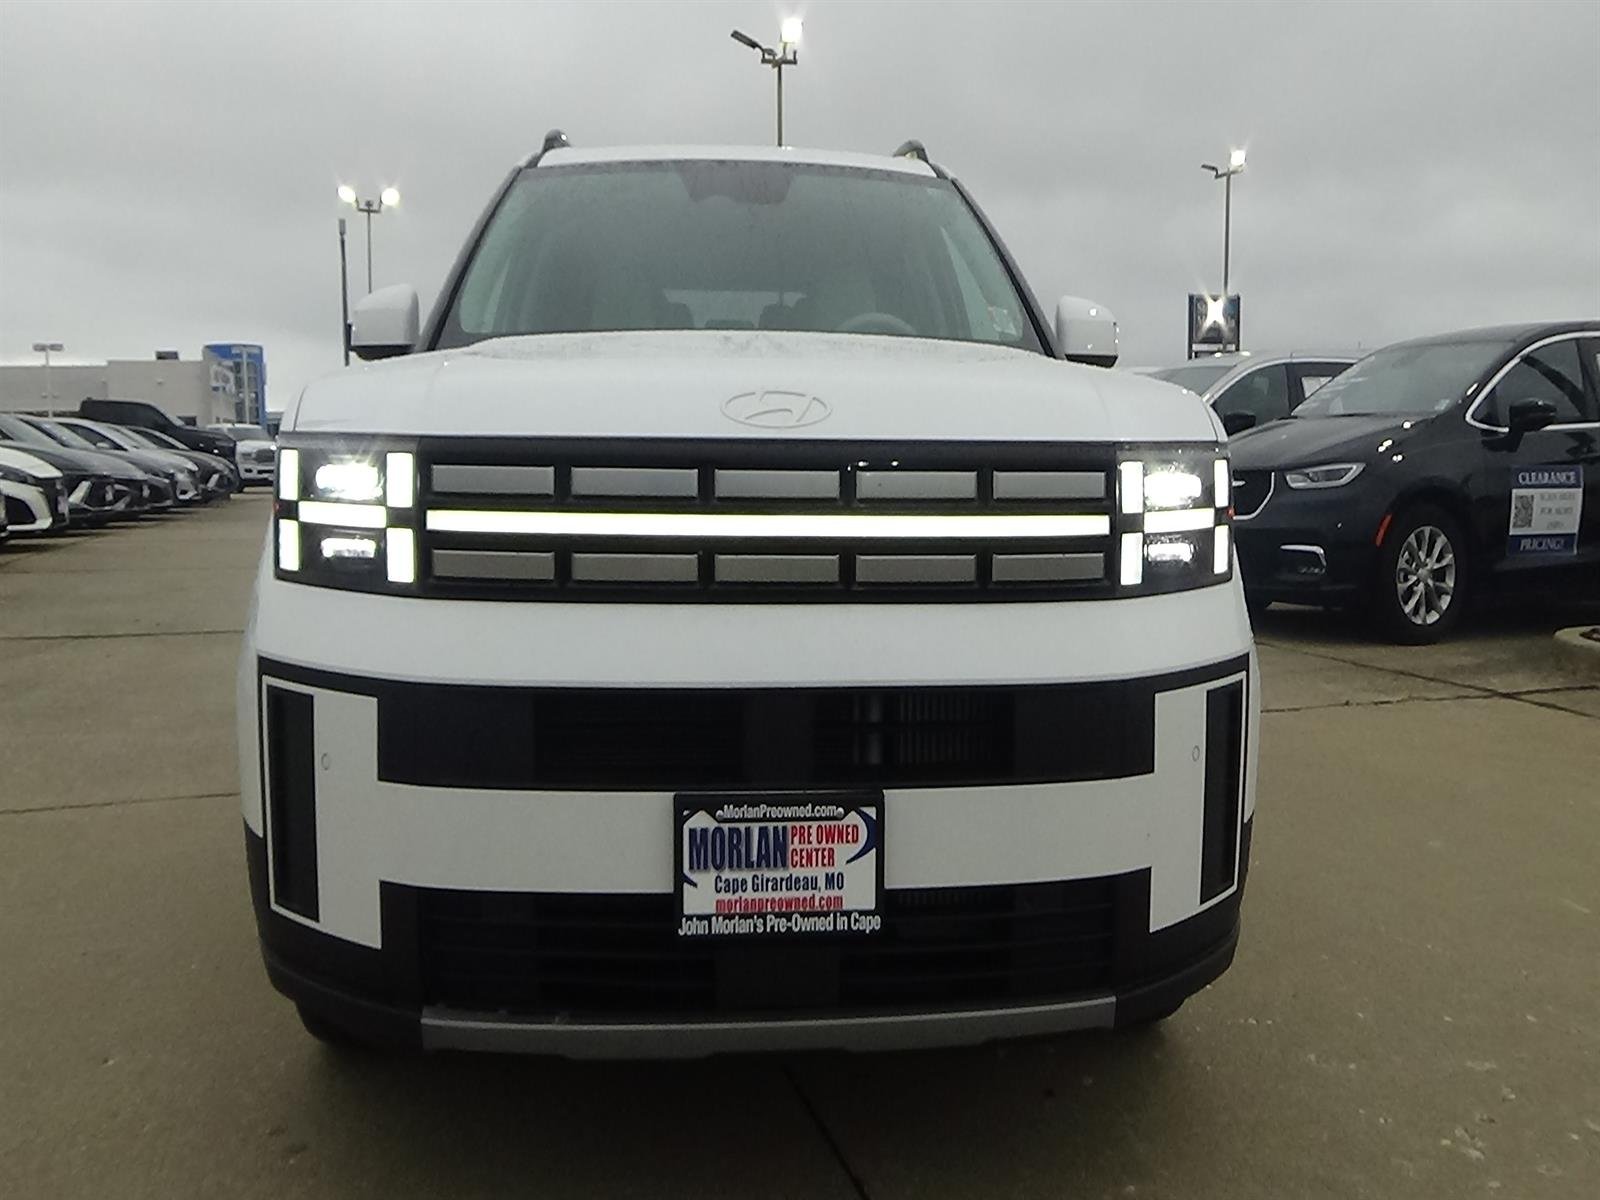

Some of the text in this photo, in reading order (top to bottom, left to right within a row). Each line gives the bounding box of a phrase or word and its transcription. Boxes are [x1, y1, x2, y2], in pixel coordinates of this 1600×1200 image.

[1518, 471, 1576, 485] CLEARANCE
[724, 804, 837, 819] MorlanPreowned.com
[791, 824, 859, 845] PRE OWNED
[688, 826, 788, 871] MORLAN
[791, 848, 835, 868] CENTER
[715, 872, 844, 896] Cape Girardeau, MO
[715, 894, 843, 913] morlanpreowned.com
[678, 914, 881, 936] John Morlan's Pre-Owned in Cape
